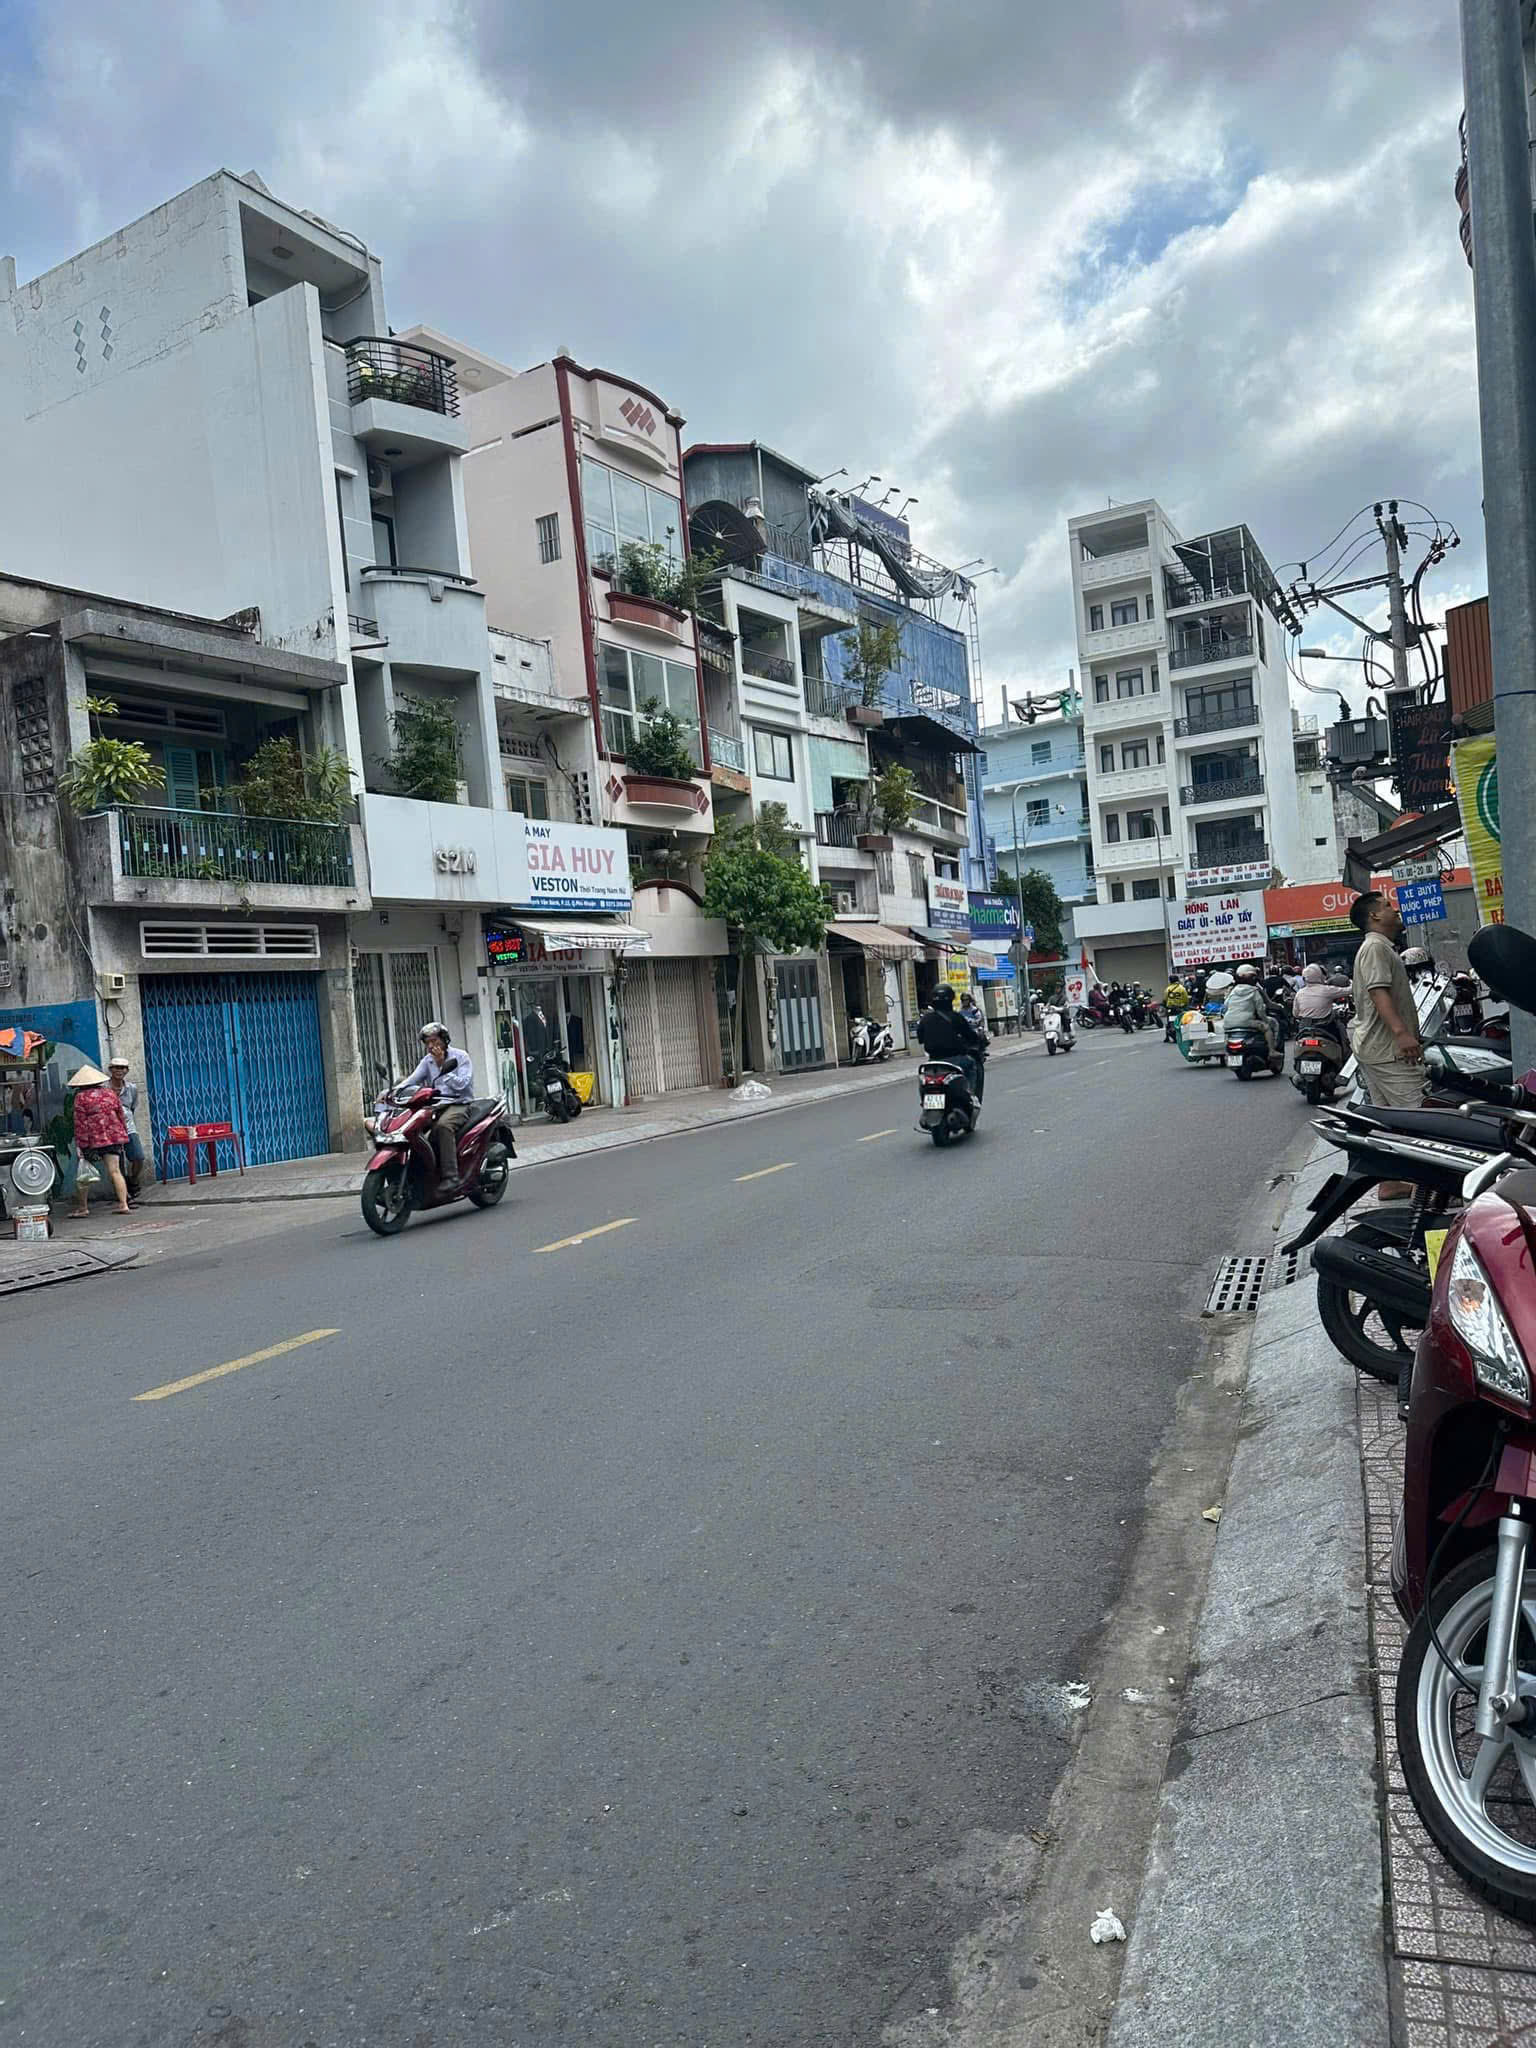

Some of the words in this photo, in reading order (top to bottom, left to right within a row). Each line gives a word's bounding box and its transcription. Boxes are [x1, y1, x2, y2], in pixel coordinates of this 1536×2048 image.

[532, 826, 551, 838] MAY
[436, 850, 479, 875] S2M
[527, 843, 566, 872] GIA
[571, 847, 615, 875] HUY
[532, 876, 578, 892] VESTON
[1404, 888, 1414, 899] XE
[1220, 898, 1239, 910] LAN
[968, 904, 1020, 929] Pharmacity
[1215, 912, 1234, 926] HẤP
[496, 952, 518, 961] VESTON
